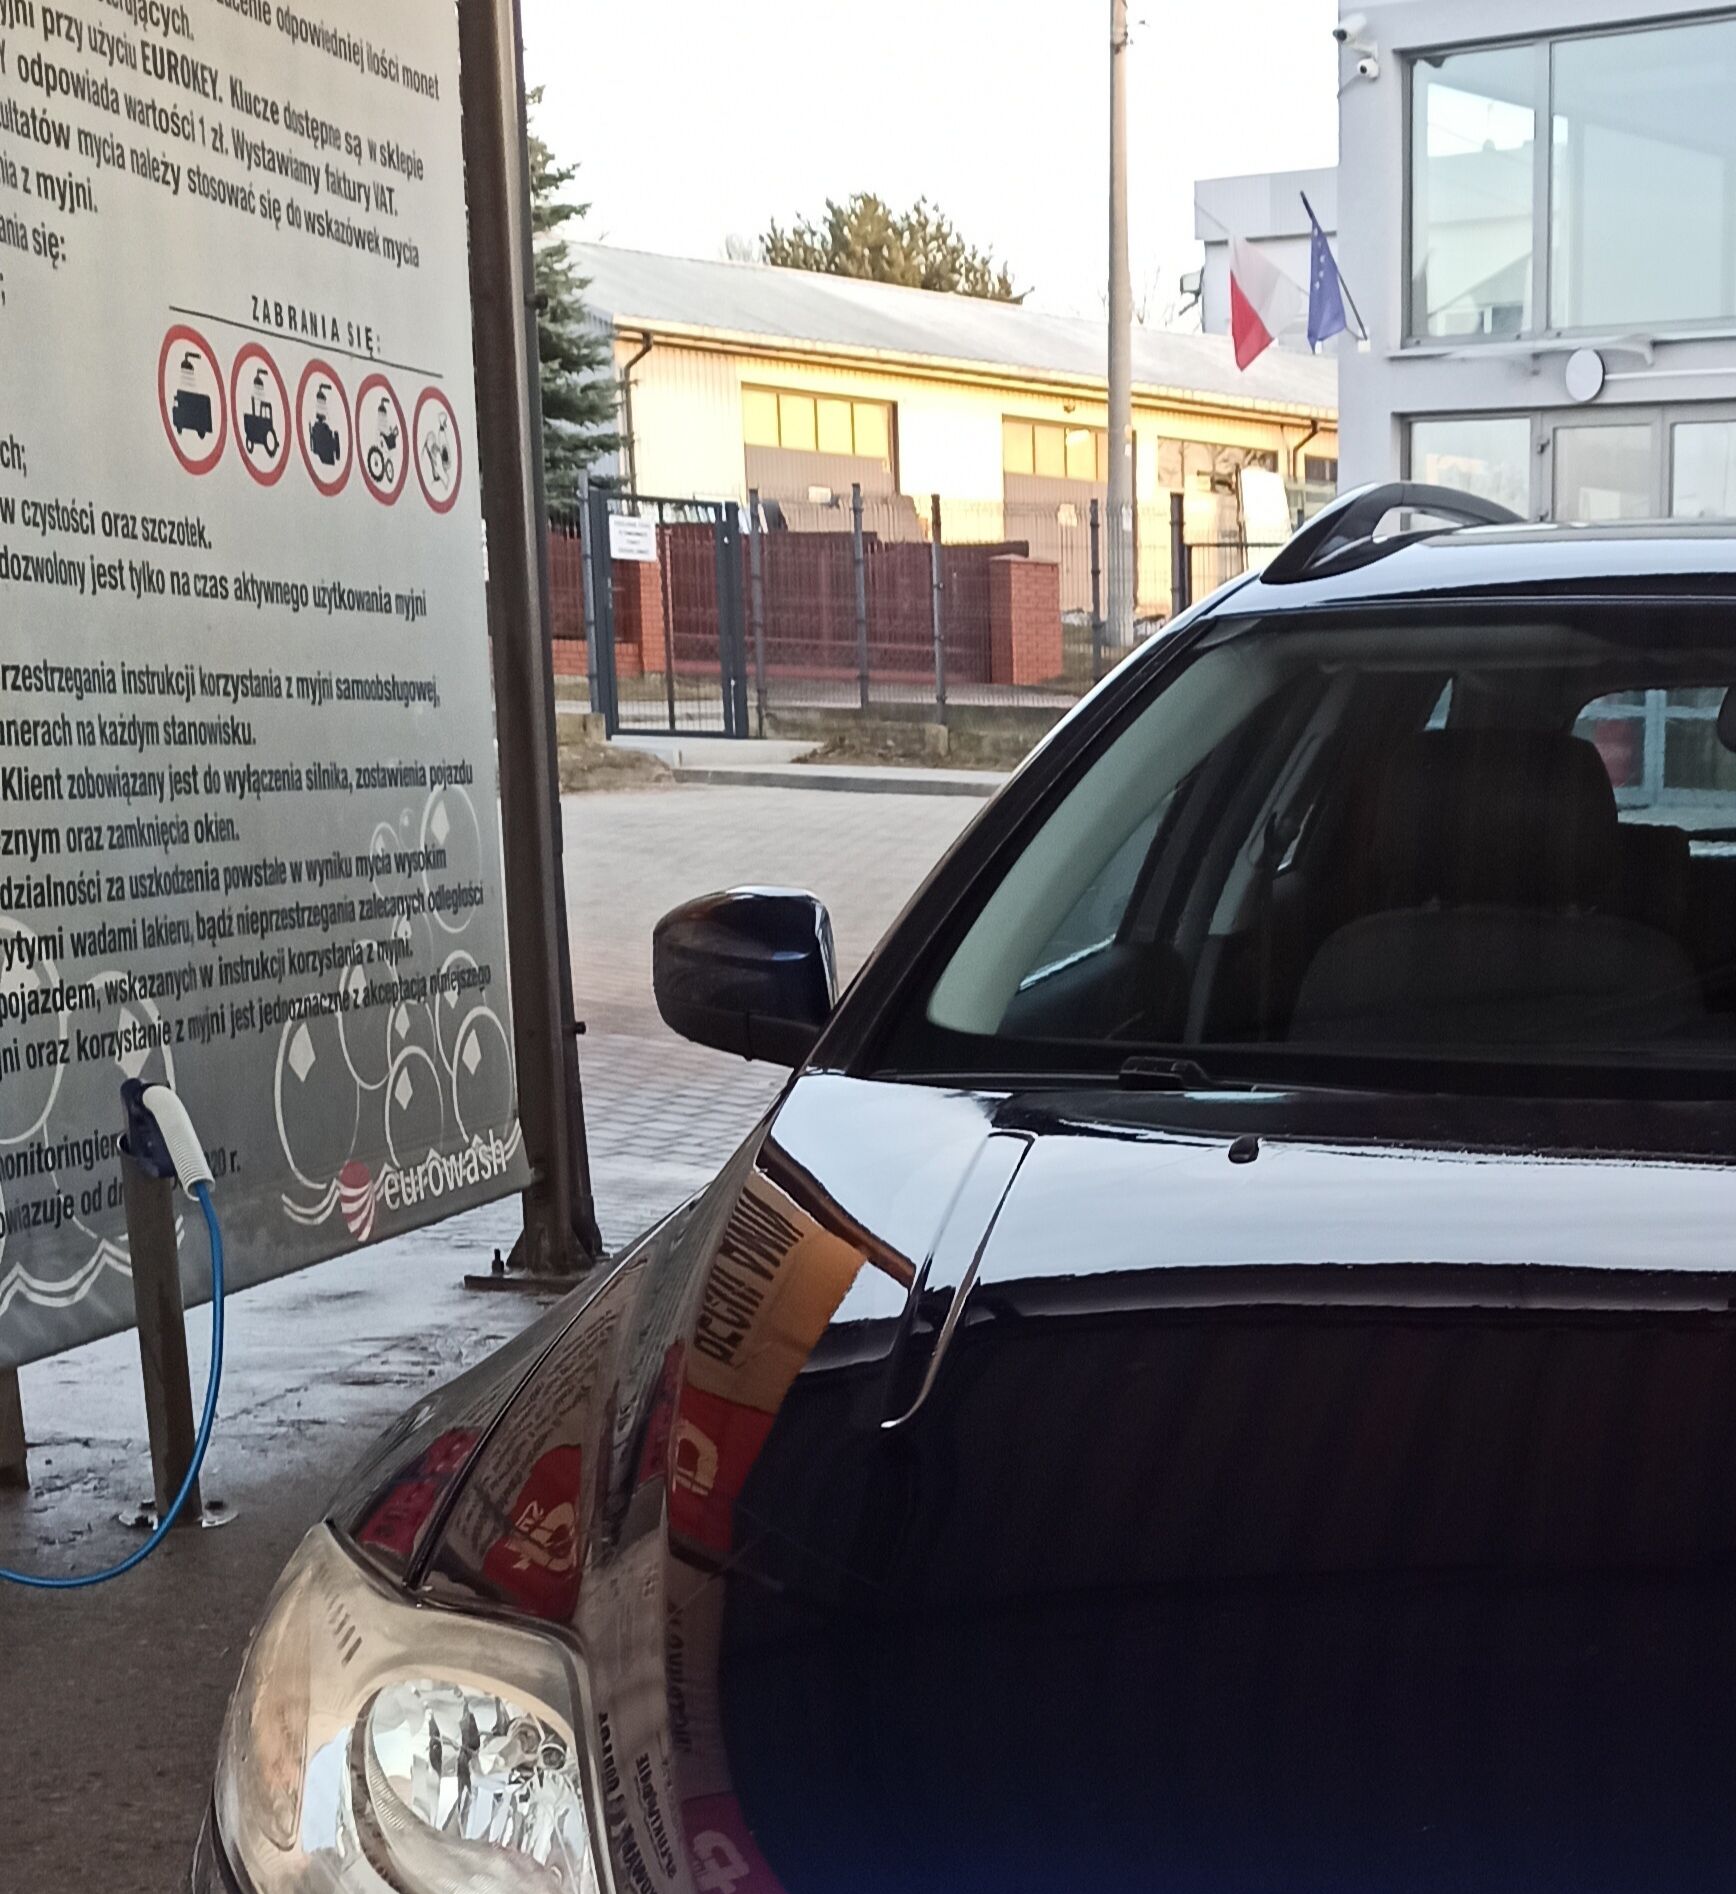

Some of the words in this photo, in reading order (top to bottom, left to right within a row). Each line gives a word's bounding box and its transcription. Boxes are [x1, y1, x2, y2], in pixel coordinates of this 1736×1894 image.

[276, 6, 364, 73] odpowiedniej
[366, 41, 399, 83] ilości
[402, 65, 439, 101] monet
[42, 5, 82, 52] przy
[88, 20, 137, 70] użyciu
[140, 39, 223, 103] EUROKEY.
[229, 74, 279, 125] Klucze
[284, 100, 341, 151] dostępne
[345, 130, 362, 165] są
[367, 137, 377, 162] w
[380, 140, 424, 181] sklepie
[17, 52, 120, 116] odpowiada
[124, 92, 196, 143] wartości
[200, 116, 206, 147] 1
[211, 122, 229, 156] zł.
[231, 126, 320, 195] Wystawiamy
[324, 162, 371, 212] faktury
[373, 181, 398, 217] VAT.
[21, 164, 32, 196] z
[36, 171, 98, 214] myjni.
[77, 126, 126, 170] mycia
[130, 147, 181, 196] należy
[187, 164, 256, 215] stosować
[260, 188, 281, 231] się
[286, 197, 301, 229] do
[304, 208, 381, 256] wskazówek
[382, 235, 420, 269] mycia
[32, 221, 67, 270] się:
[251, 294, 341, 344] ZABRANIA
[346, 319, 381, 359] SIĘ:
[20, 497, 96, 538] czystości
[101, 508, 139, 540] oraz
[141, 515, 213, 550] szczotek.
[0, 544, 86, 595] dozwolony
[90, 554, 126, 596] jest
[129, 559, 166, 600] tylko
[170, 570, 191, 598] na
[193, 572, 229, 600] czas
[233, 570, 309, 614] aktywnego
[312, 578, 393, 616] użytkowania
[395, 587, 427, 623] myjni
[1, 658, 117, 701] rzestrzegania
[120, 660, 196, 704] instrukcji
[199, 664, 282, 705] korzystania
[286, 675, 294, 700] z
[296, 669, 335, 707] myjni
[76, 721, 96, 747] na
[99, 713, 160, 753] każdym
[163, 714, 257, 747] stanowisku.
[1, 765, 64, 802] Klient
[67, 764, 164, 806] zobowiązany
[168, 764, 200, 802] jest
[203, 763, 221, 796] do
[223, 762, 303, 801] wyłączenia
[306, 761, 353, 795] silnika,
[355, 759, 427, 790] zostawienia
[430, 757, 473, 792] pojazdu
[66, 824, 104, 853] oraz
[107, 812, 190, 855] zamknięcia
[194, 811, 240, 844] okien.
[0, 870, 102, 911] dzialności
[106, 875, 126, 902] za
[129, 860, 220, 901] uszkodzenia
[223, 856, 288, 897] powstałe
[290, 860, 303, 885] w
[305, 851, 353, 888] wyniku
[355, 850, 392, 883] mycia
[394, 842, 447, 879] wysokim
[70, 918, 138, 960] wadami
[141, 914, 195, 949] lakieru,
[195, 903, 234, 948] bądź
[236, 894, 355, 940] nieprzestrzegania
[359, 886, 426, 922] zalecanych
[427, 881, 484, 916] odległości
[105, 961, 197, 1006] wskazanych
[199, 963, 214, 989] w
[219, 946, 285, 988] instrukcji
[288, 935, 364, 977] korzystania
[366, 941, 375, 965] z
[377, 930, 414, 967] myjni.
[25, 1038, 70, 1070] oraz
[76, 1015, 171, 1064] korzystanie
[176, 1018, 186, 1043] z
[188, 1004, 226, 1046] myjni
[229, 998, 255, 1040] jest
[258, 989, 350, 1033] jednoznaczne
[353, 987, 361, 1010] z
[429, 963, 491, 998] niniejszego
[81, 1180, 102, 1215] od
[384, 1128, 508, 1211] eurowash
